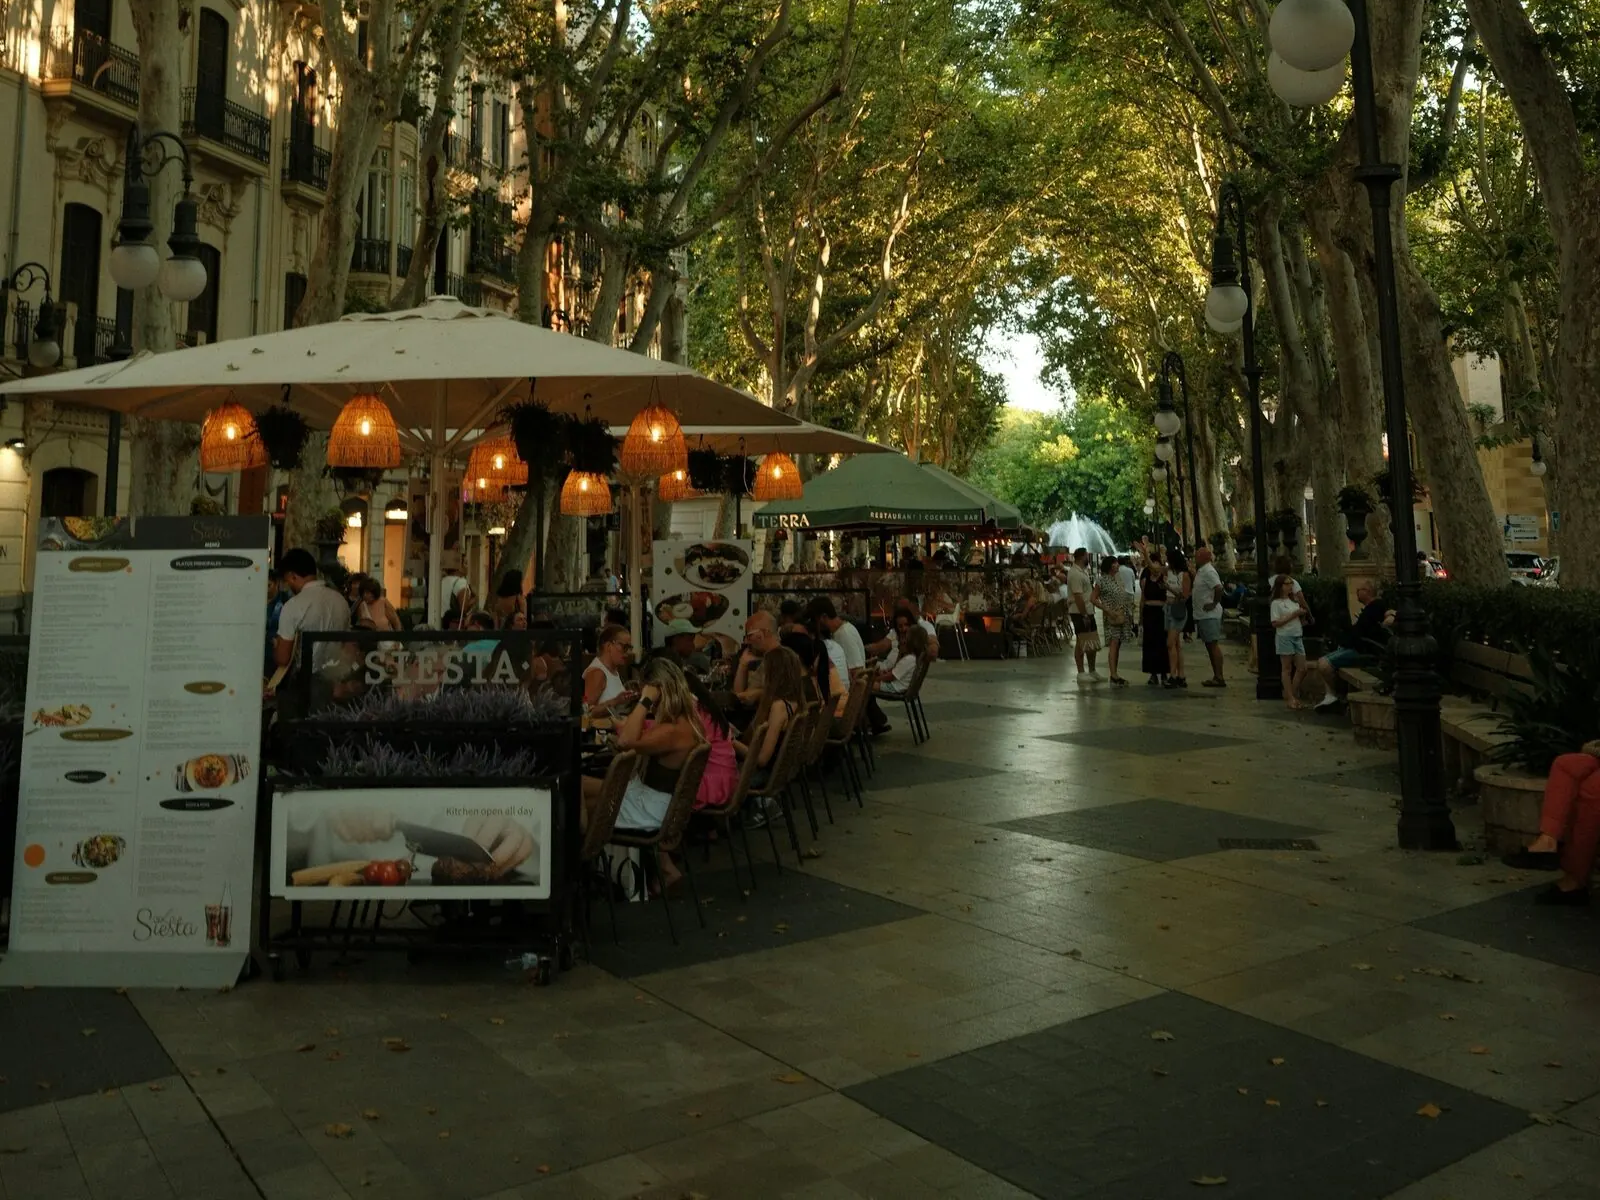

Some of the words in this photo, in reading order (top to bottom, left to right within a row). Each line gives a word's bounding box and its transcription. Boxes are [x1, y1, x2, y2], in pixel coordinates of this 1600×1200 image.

[758, 513, 810, 528] TERRA
[870, 511, 916, 520] RESTAURANT
[364, 649, 520, 686] SIESTA
[445, 807, 479, 816] Kitchen
[480, 808, 503, 817] open
[504, 806, 516, 816] all
[517, 806, 534, 817] day
[132, 907, 199, 942] Siesta
